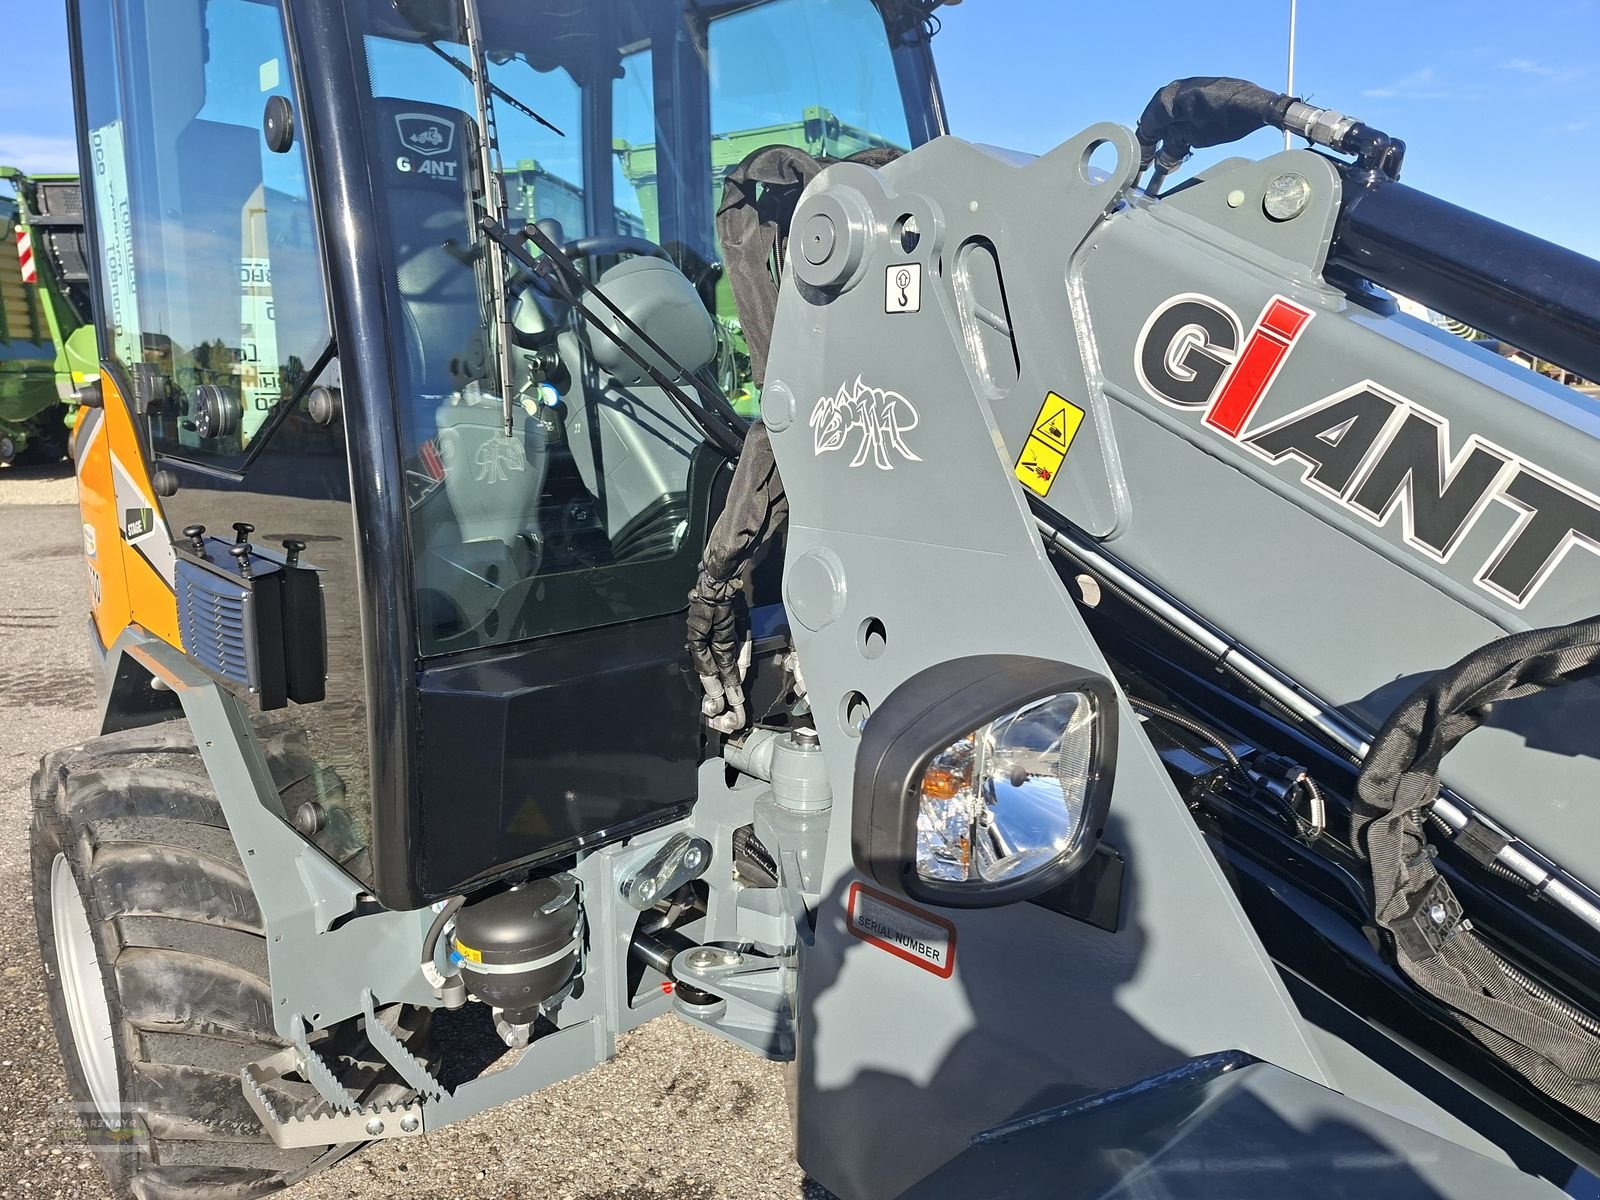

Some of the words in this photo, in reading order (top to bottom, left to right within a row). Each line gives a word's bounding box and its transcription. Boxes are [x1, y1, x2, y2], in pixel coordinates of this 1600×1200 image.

[396, 156, 457, 177] GANT
[128, 519, 143, 537] STAGE
[858, 916, 893, 940] SERIAL
[895, 933, 940, 961] NUMBER
